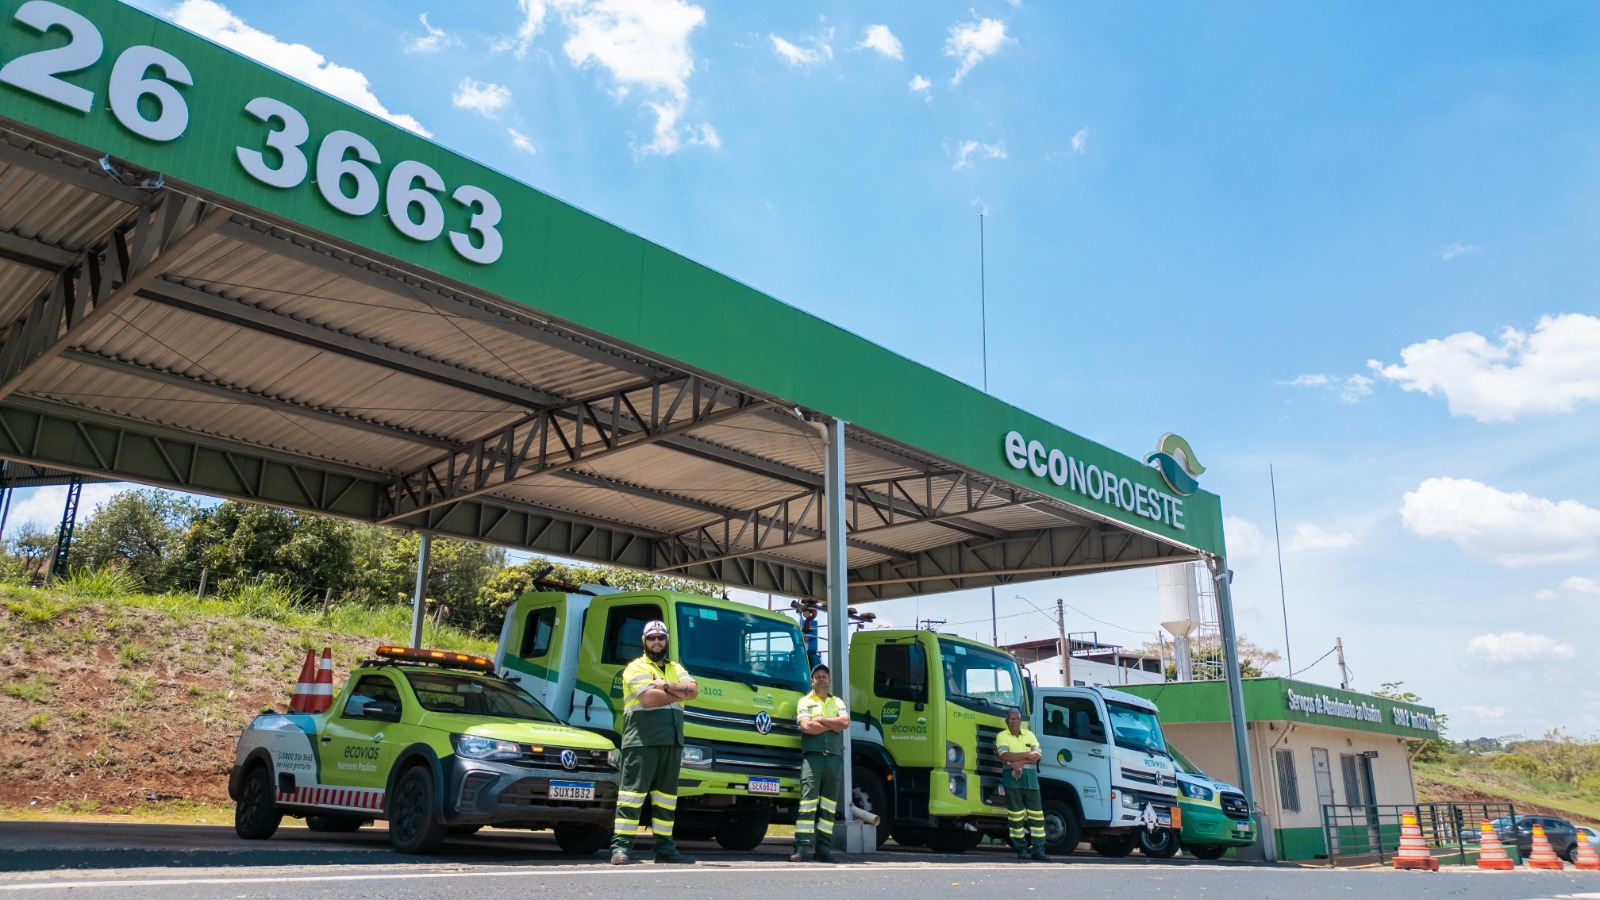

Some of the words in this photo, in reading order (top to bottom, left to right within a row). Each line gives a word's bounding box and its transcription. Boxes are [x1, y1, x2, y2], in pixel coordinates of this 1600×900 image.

[0, 0, 193, 142] 26
[236, 97, 504, 264] 3663
[1005, 430, 1185, 530] ecoNOROESTE
[697, 686, 723, 696] -3102
[1288, 688, 1315, 717] Serviços
[1315, 693, 1323, 713] de
[1323, 694, 1356, 719] Atendimento
[1356, 705, 1363, 720] ao
[891, 725, 927, 734] ecovias
[344, 745, 380, 760] ecovias
[276, 761, 293, 770] serviço
[337, 761, 358, 771] Noroeste
[358, 762, 377, 772] Paulista
[553, 786, 591, 799] SUX1B32
